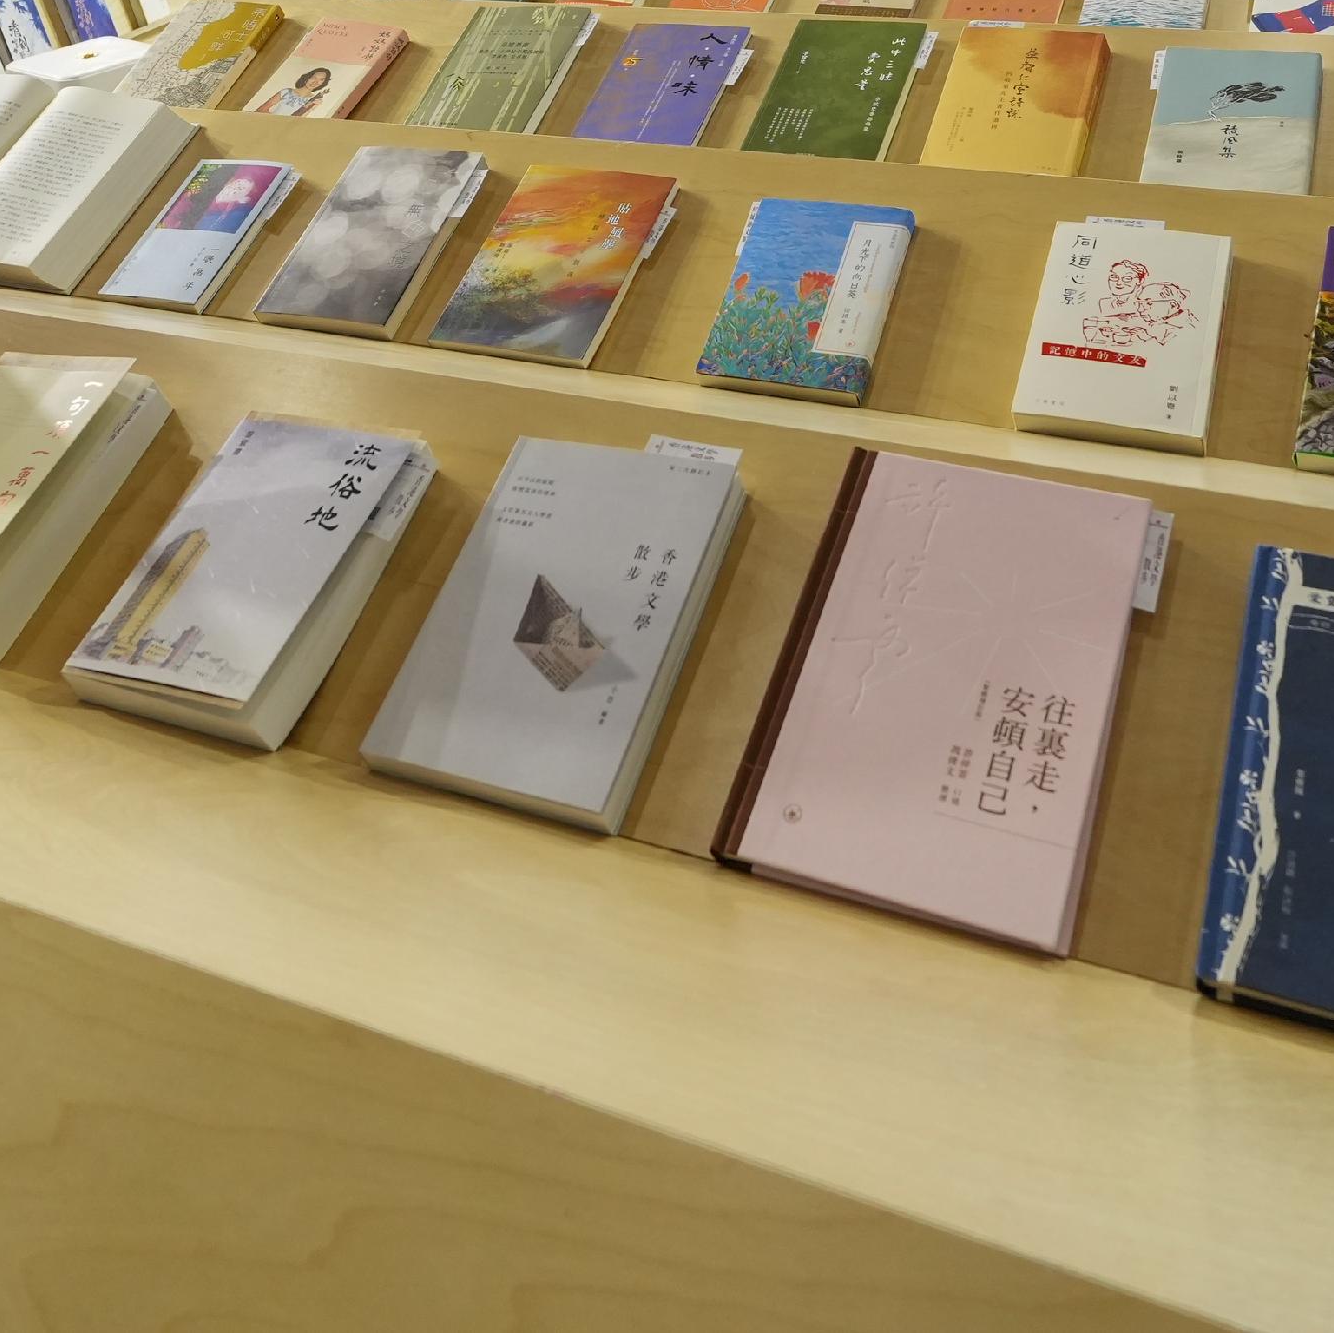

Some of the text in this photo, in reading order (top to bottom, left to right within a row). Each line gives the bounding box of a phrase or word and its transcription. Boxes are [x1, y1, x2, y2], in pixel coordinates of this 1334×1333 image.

[305, 444, 382, 531] 流俗地
[625, 544, 652, 582] 散步
[633, 548, 678, 631] 香港文學
[978, 686, 1035, 816] 安頓自己
